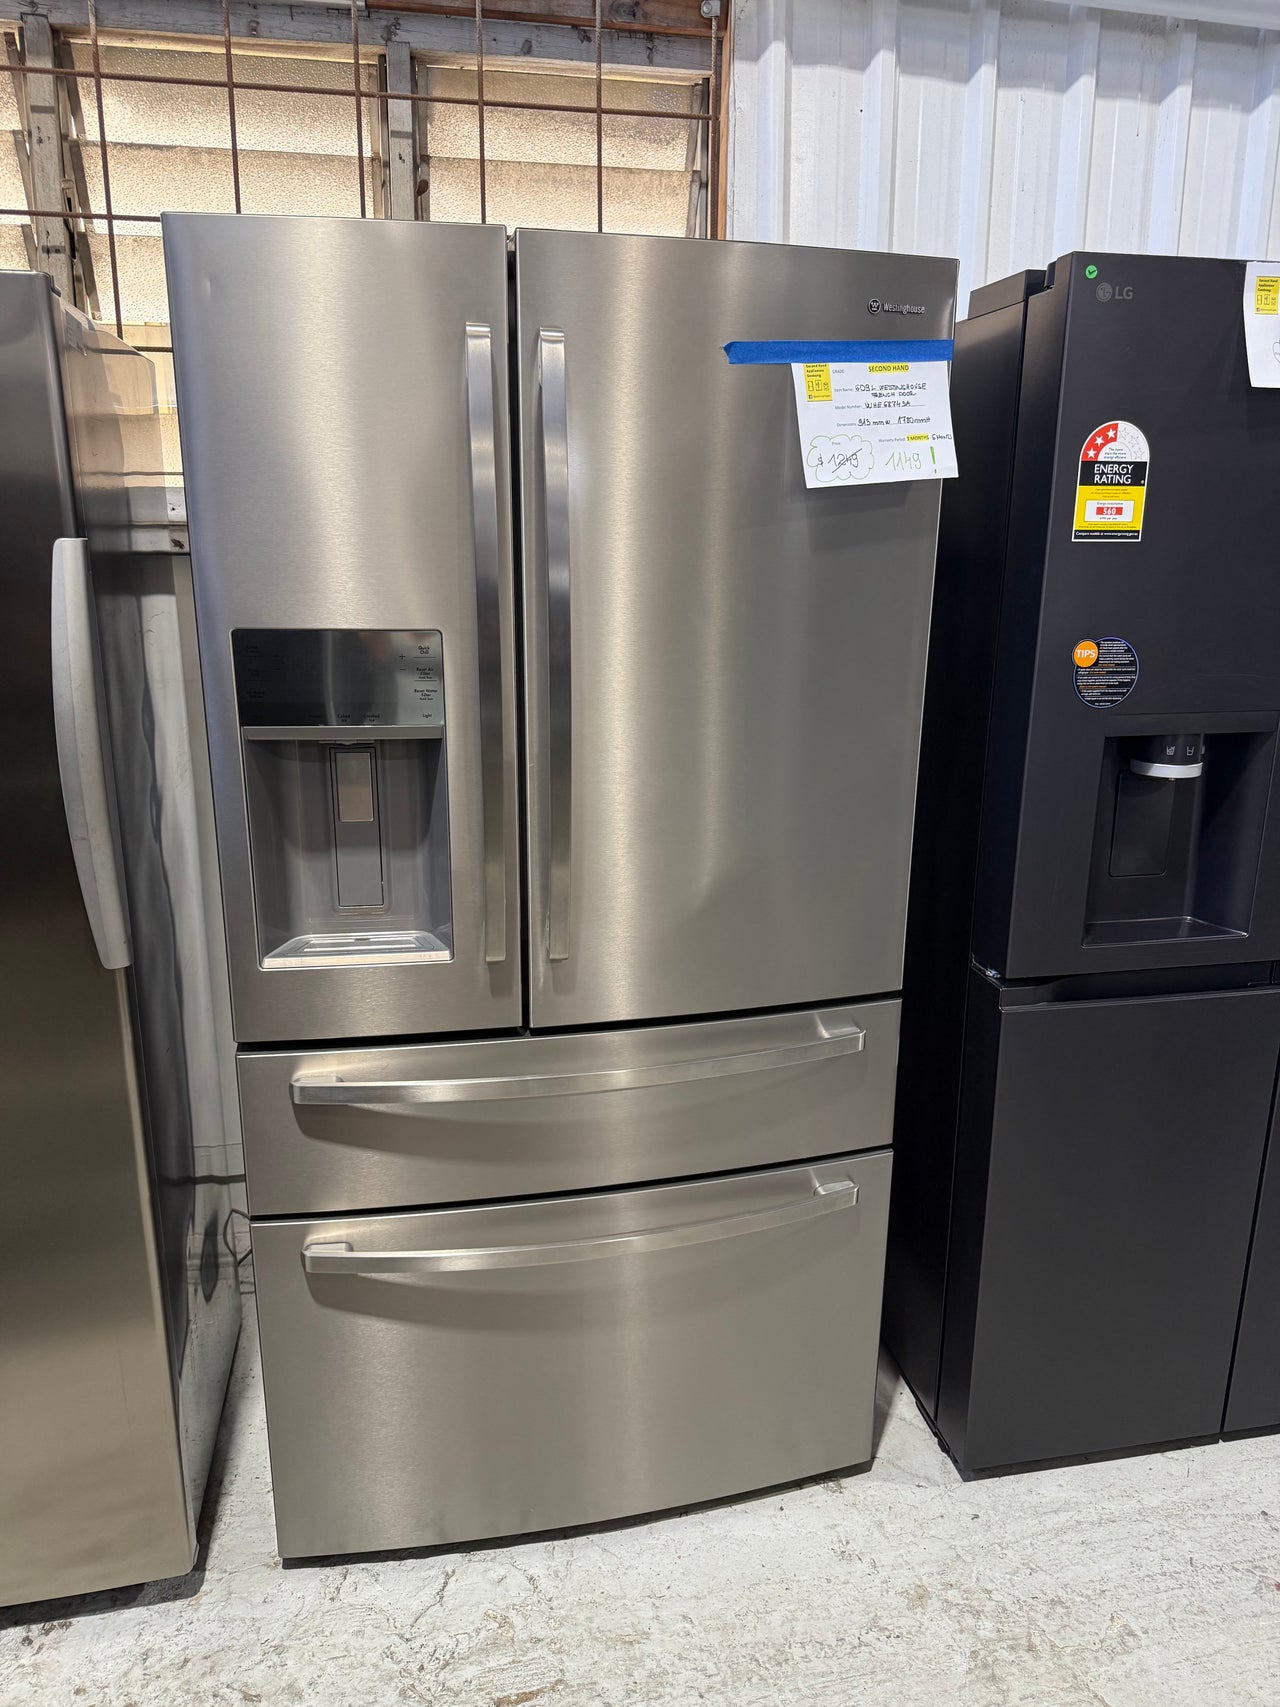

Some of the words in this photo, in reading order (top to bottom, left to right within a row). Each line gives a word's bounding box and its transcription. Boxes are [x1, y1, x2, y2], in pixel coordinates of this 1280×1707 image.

[1114, 286, 1134, 300] LG
[883, 302, 926, 315] Westinghouse
[885, 451, 922, 471] 1149
[1094, 464, 1134, 474] ENERGY
[1094, 474, 1132, 484] RATING
[1076, 650, 1096, 658] TIPS
